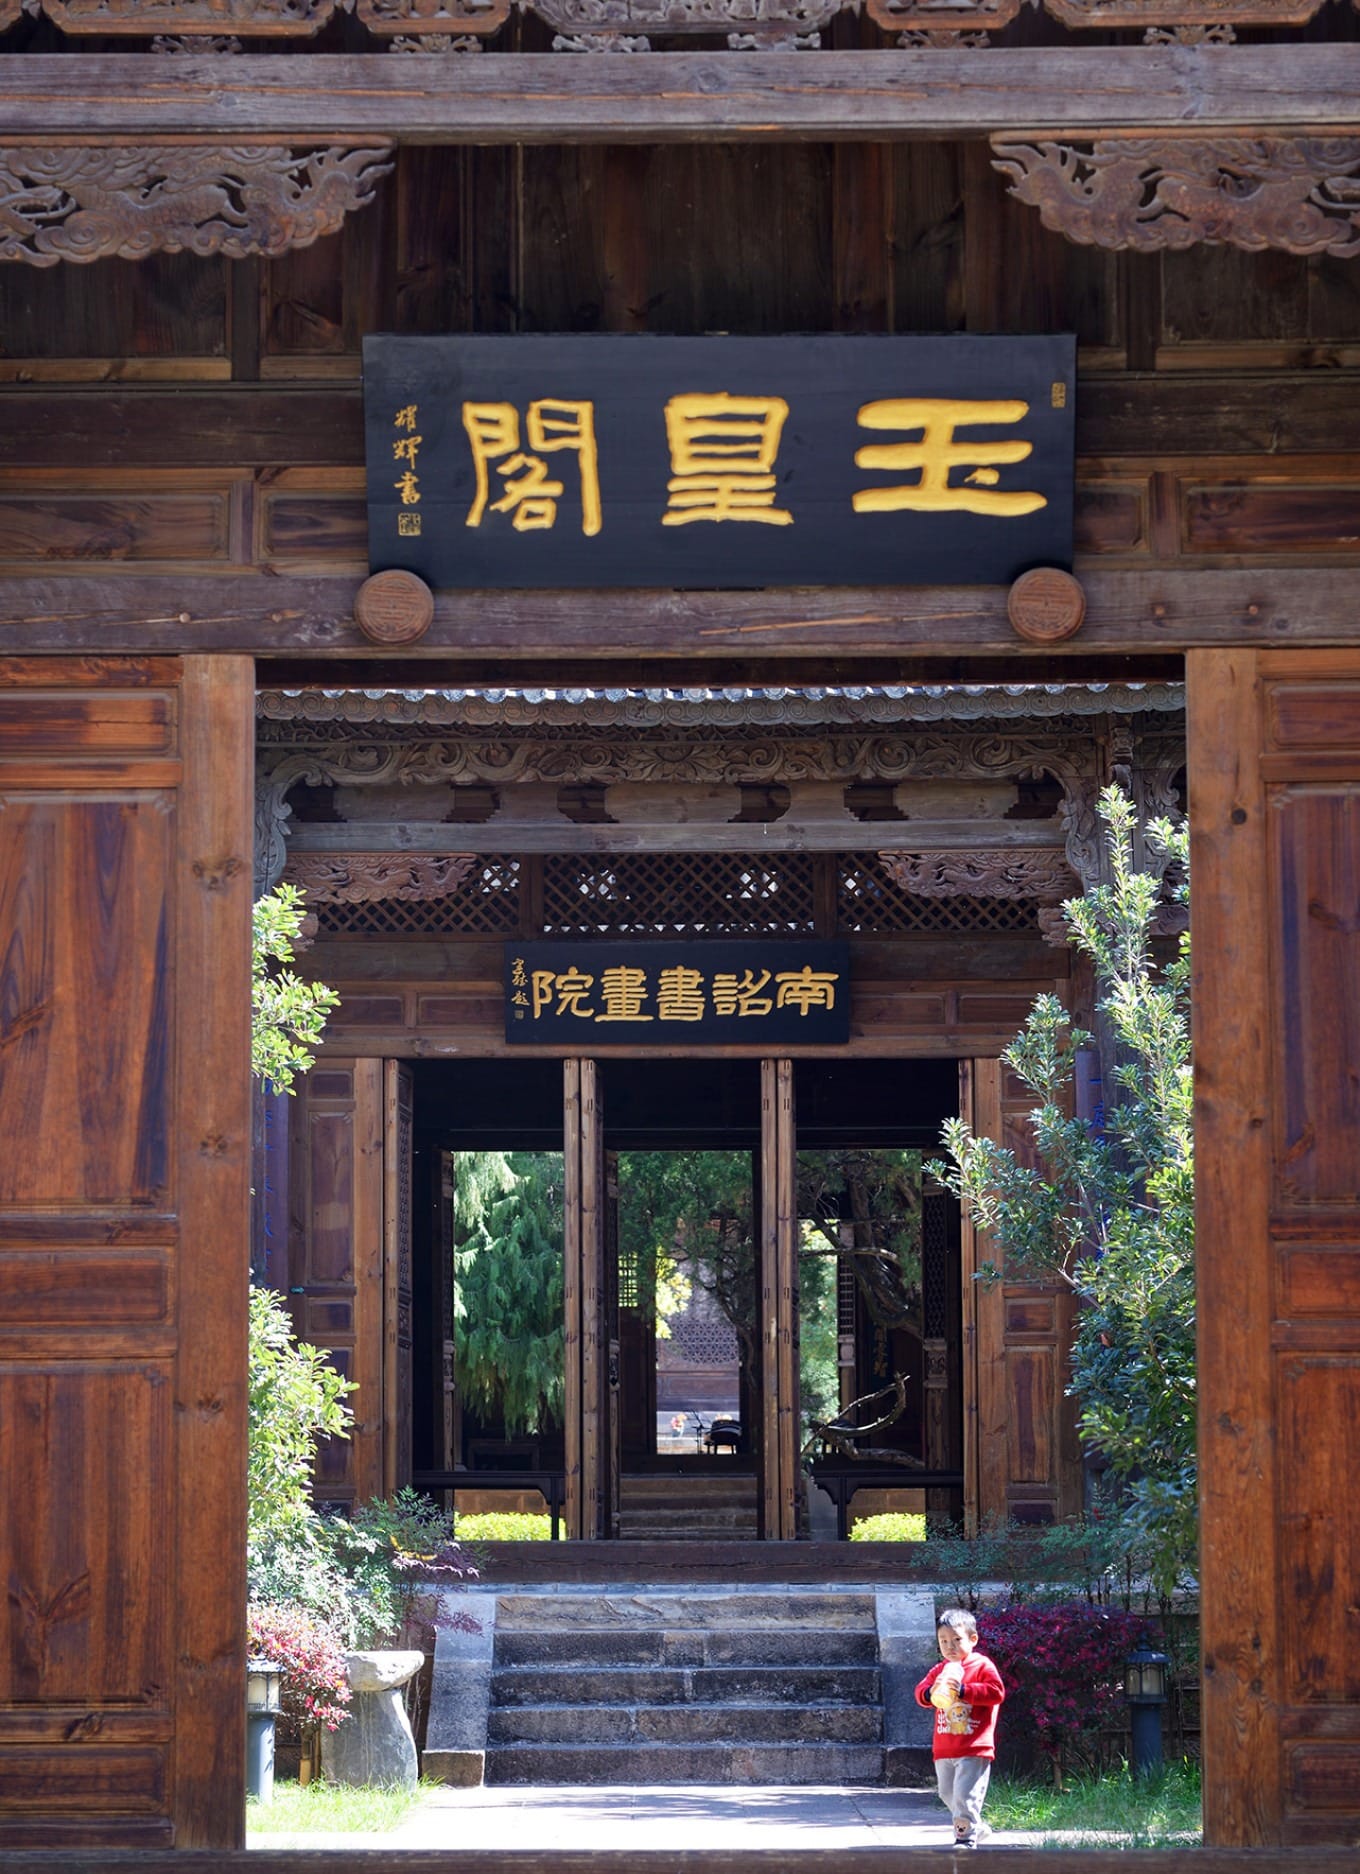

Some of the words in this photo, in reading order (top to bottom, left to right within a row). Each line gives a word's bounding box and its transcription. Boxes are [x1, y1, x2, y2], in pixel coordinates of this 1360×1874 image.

[461, 391, 1048, 537] 玉皇閣
[531, 965, 839, 1022] 南詔書畫院
